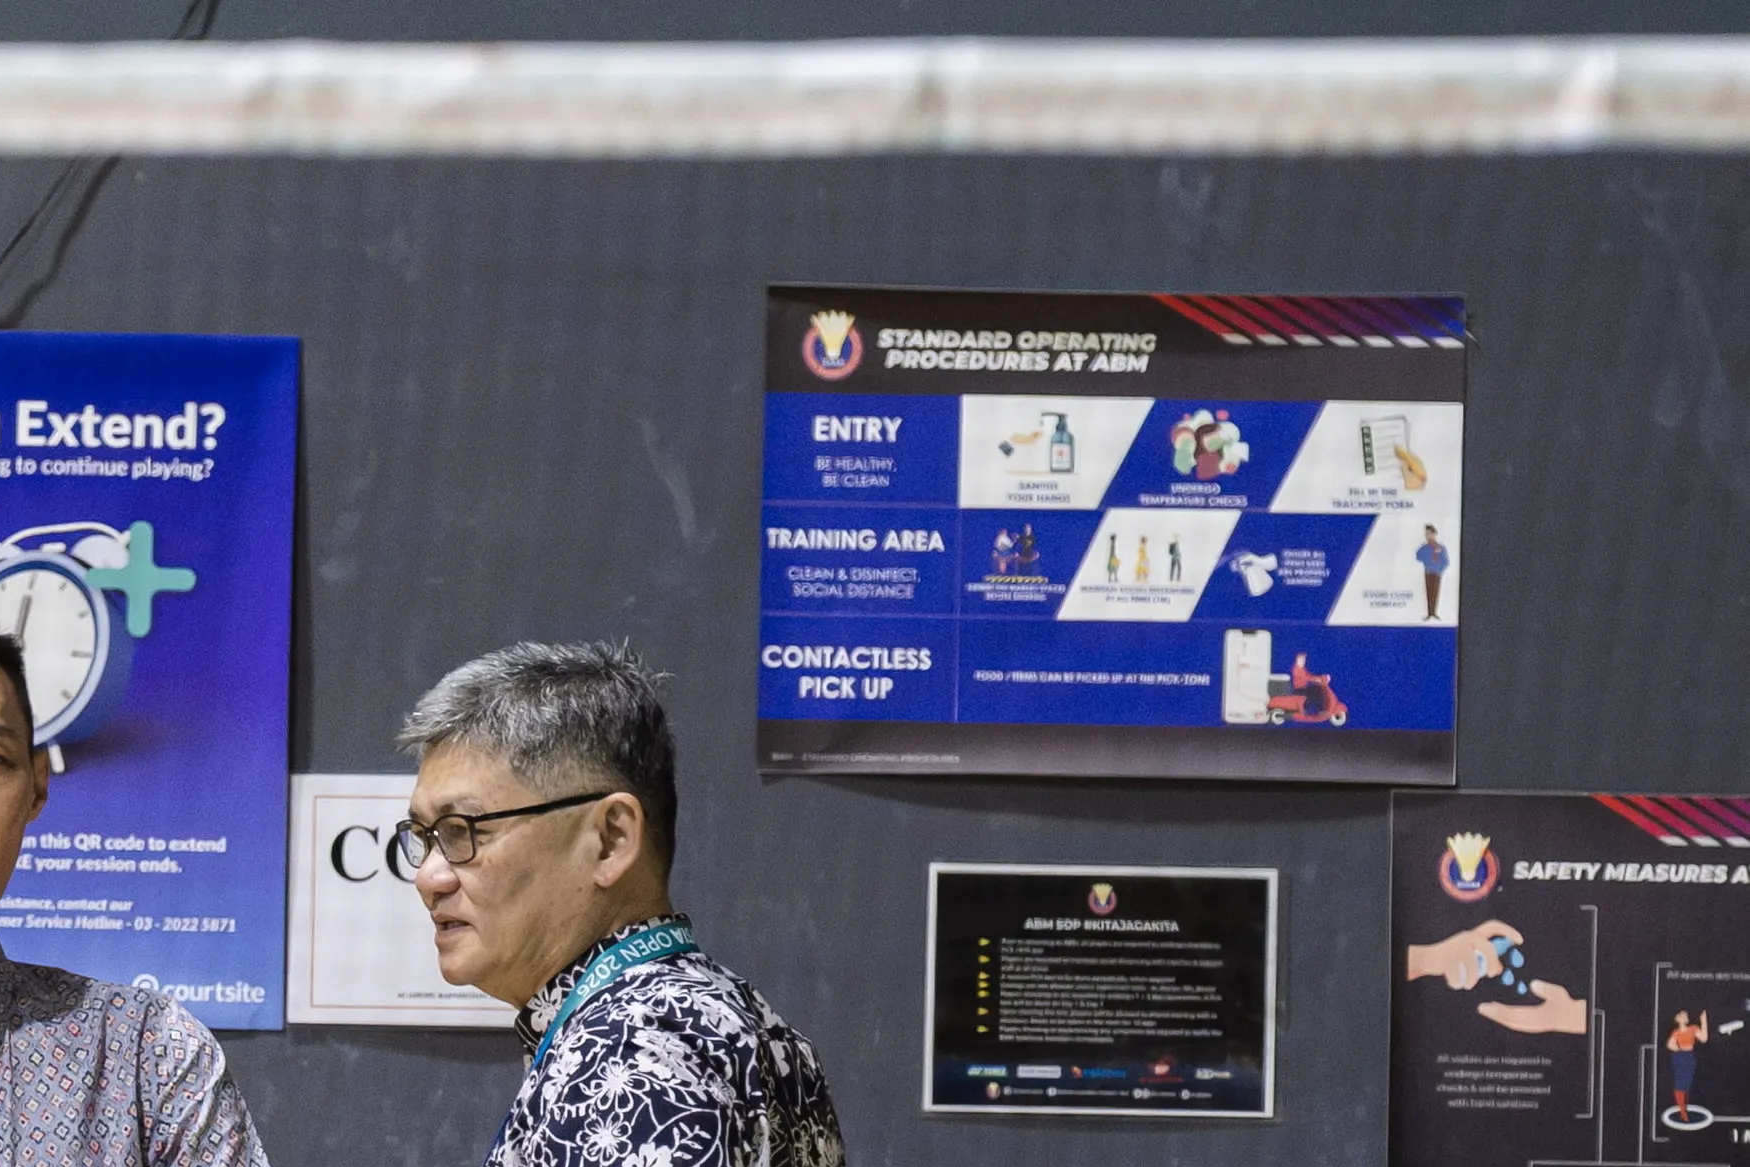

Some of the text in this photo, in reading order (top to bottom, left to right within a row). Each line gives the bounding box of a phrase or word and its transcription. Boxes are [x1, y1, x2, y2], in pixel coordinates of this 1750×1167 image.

[877, 328, 1157, 351] STANDARD OPERATING
[885, 349, 1149, 374] PROCEDURES AT ABM
[16, 400, 226, 450] Extend?
[812, 415, 903, 443] ENTRY
[15, 457, 36, 475] to
[40, 456, 128, 476] continue
[131, 457, 214, 481] playing?
[815, 456, 833, 471] BE
[822, 473, 890, 488] BE CLEAN
[767, 527, 944, 552] TRAINING AREA
[788, 567, 834, 581] CLEAN
[838, 568, 848, 581] &
[793, 582, 913, 599] SOCIAL DISTANCE
[762, 645, 932, 670] CONTACTLESS
[799, 676, 893, 700] PICK UP
[40, 833, 70, 850] this
[73, 833, 102, 852] QR
[104, 835, 145, 851] code
[149, 837, 166, 851] to
[168, 837, 226, 852] extend
[35, 857, 73, 872] your
[76, 856, 136, 872] session
[1513, 861, 1750, 884] SAFETY MEASURES A
[57, 900, 108, 911] contact
[109, 901, 134, 912] our
[25, 914, 72, 929] Service
[75, 916, 123, 930] Hotline
[134, 916, 153, 931] 03
[162, 917, 198, 932] 2022
[1024, 918, 1053, 930] ABM
[1056, 918, 1081, 930] SOP
[619, 932, 672, 962] OPEN
[577, 954, 622, 996] 2026
[162, 980, 265, 1003] courtsite
